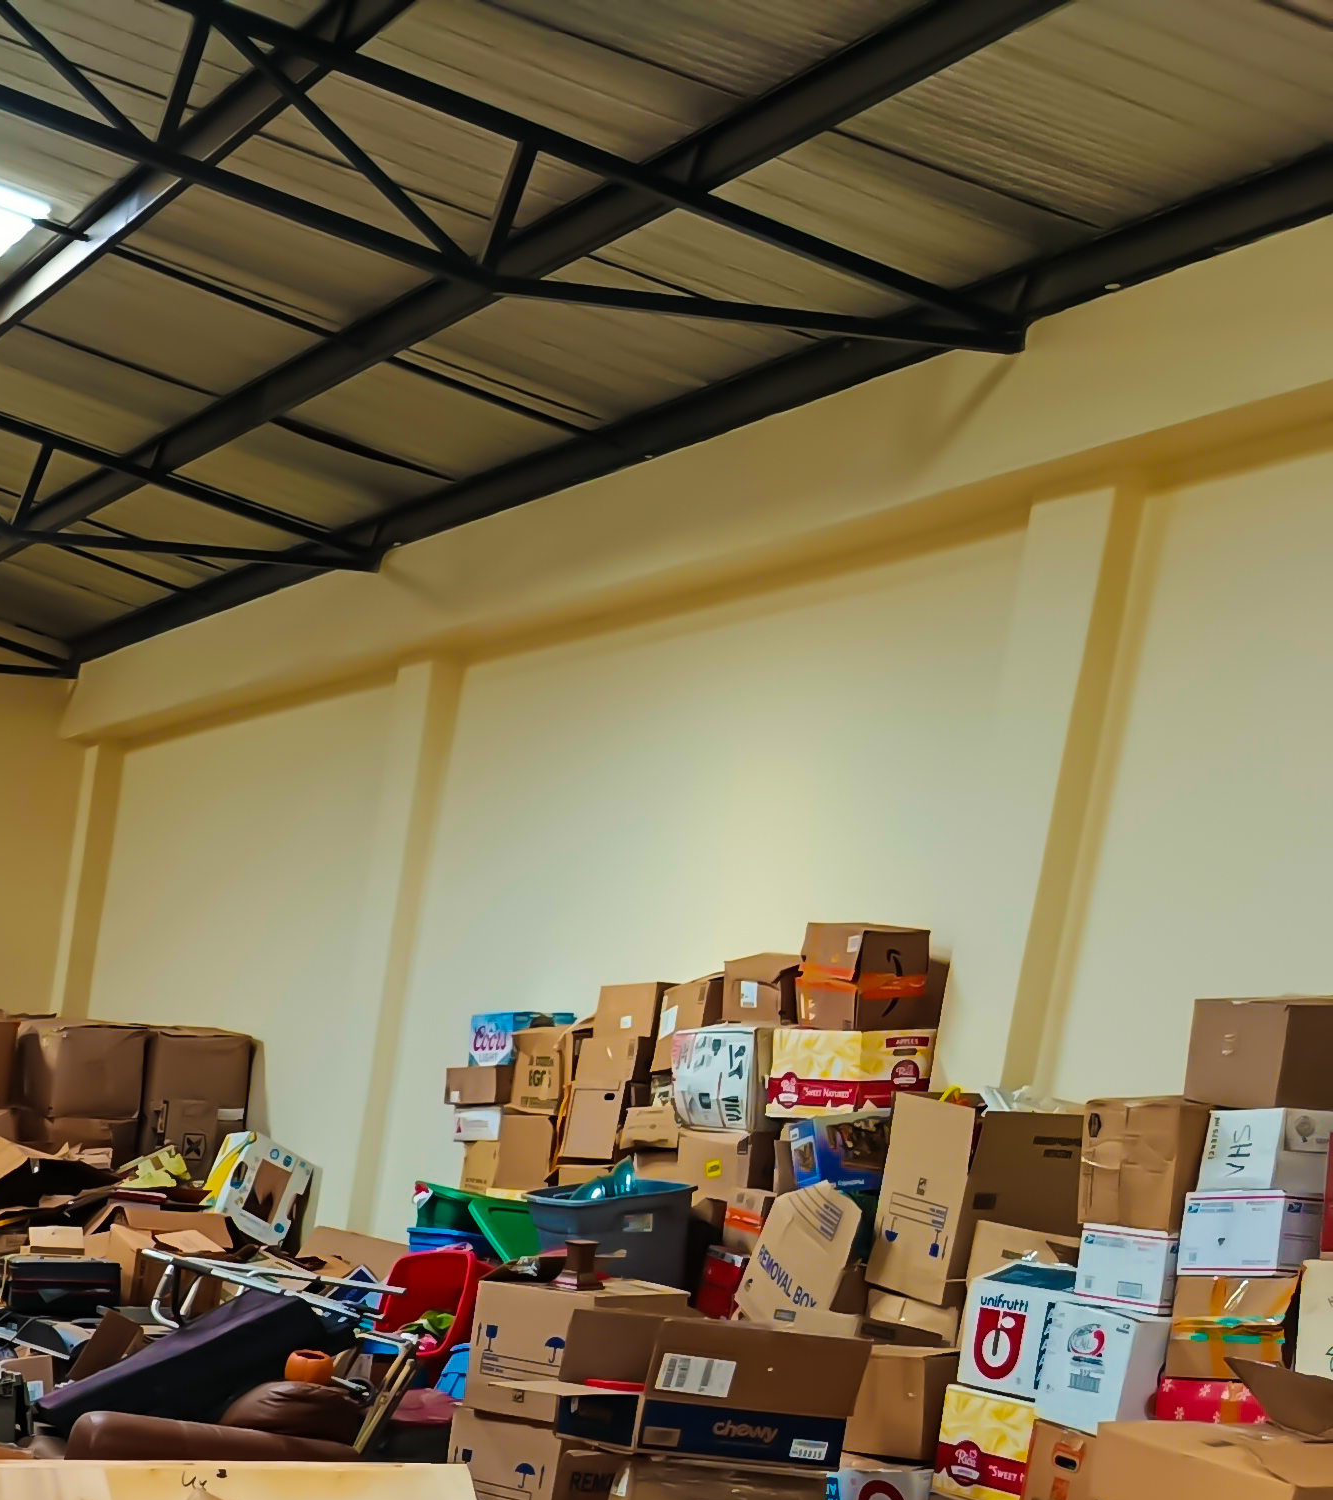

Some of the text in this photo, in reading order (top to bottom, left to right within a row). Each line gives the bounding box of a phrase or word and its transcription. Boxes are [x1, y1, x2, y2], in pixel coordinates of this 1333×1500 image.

[472, 1025, 507, 1052] Coors
[1224, 1124, 1253, 1177] VHS
[980, 1293, 1030, 1313] unifrutti
[712, 1419, 779, 1444] chewy
